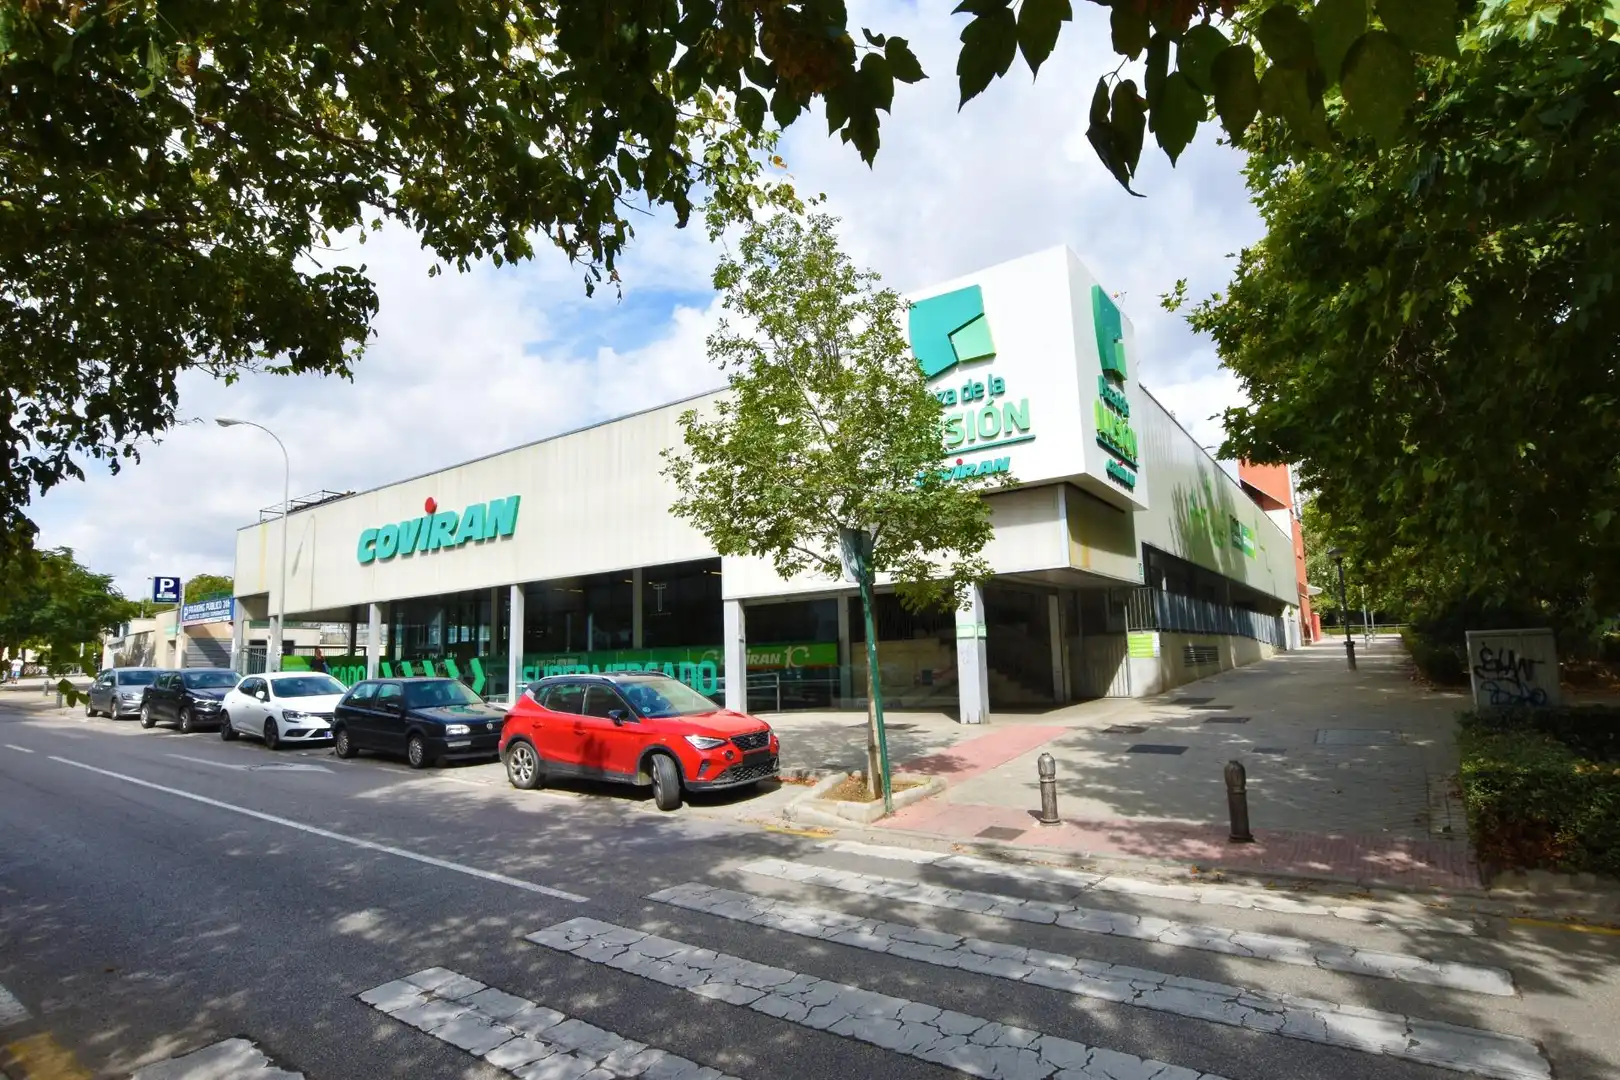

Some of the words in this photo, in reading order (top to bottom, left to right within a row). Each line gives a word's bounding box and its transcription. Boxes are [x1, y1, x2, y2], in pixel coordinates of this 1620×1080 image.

[937, 388, 957, 406] za
[961, 379, 984, 401] de
[988, 374, 1005, 396] la
[942, 398, 1030, 445] SIÓN
[357, 495, 521, 563] COVIRAN
[160, 578, 175, 593] P
[329, 665, 367, 688] CADO
